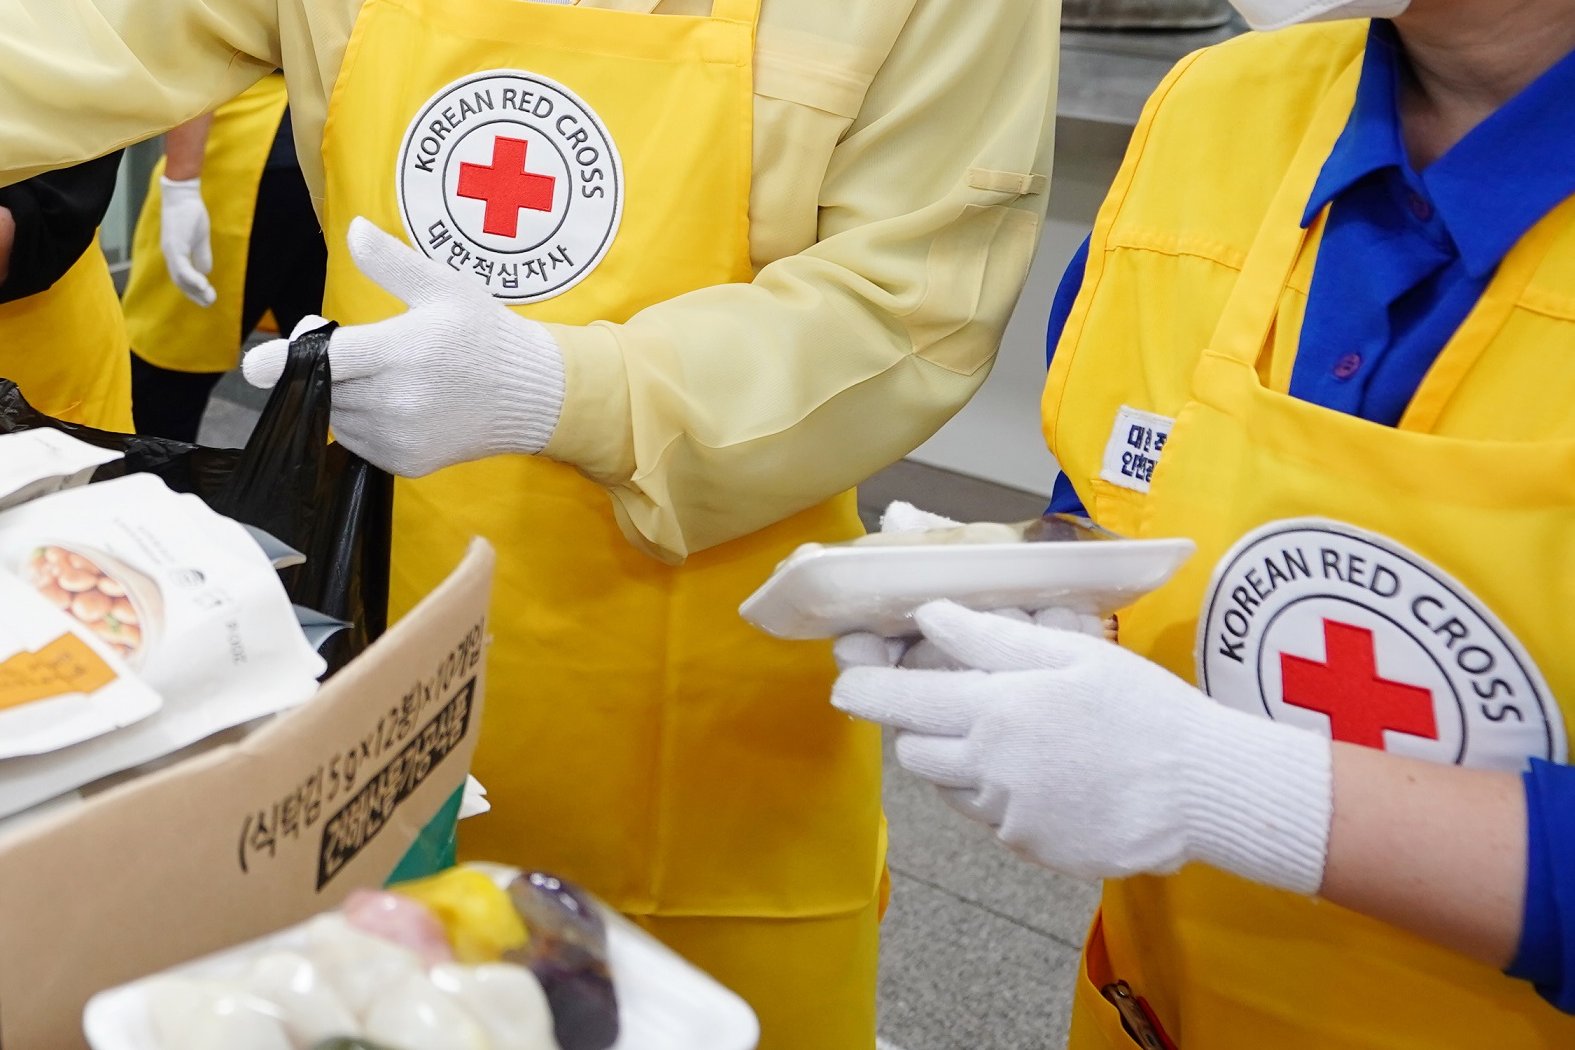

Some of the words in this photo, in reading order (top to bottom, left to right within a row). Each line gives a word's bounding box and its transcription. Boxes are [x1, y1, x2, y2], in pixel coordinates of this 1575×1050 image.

[414, 88, 495, 174] KOREAN
[501, 87, 555, 120] RED
[555, 113, 605, 200] CROSS
[427, 218, 575, 289] 대한적십자사
[1218, 547, 1312, 664] KOREAN
[1322, 547, 1401, 598] RED
[1410, 594, 1523, 724] CROSS
